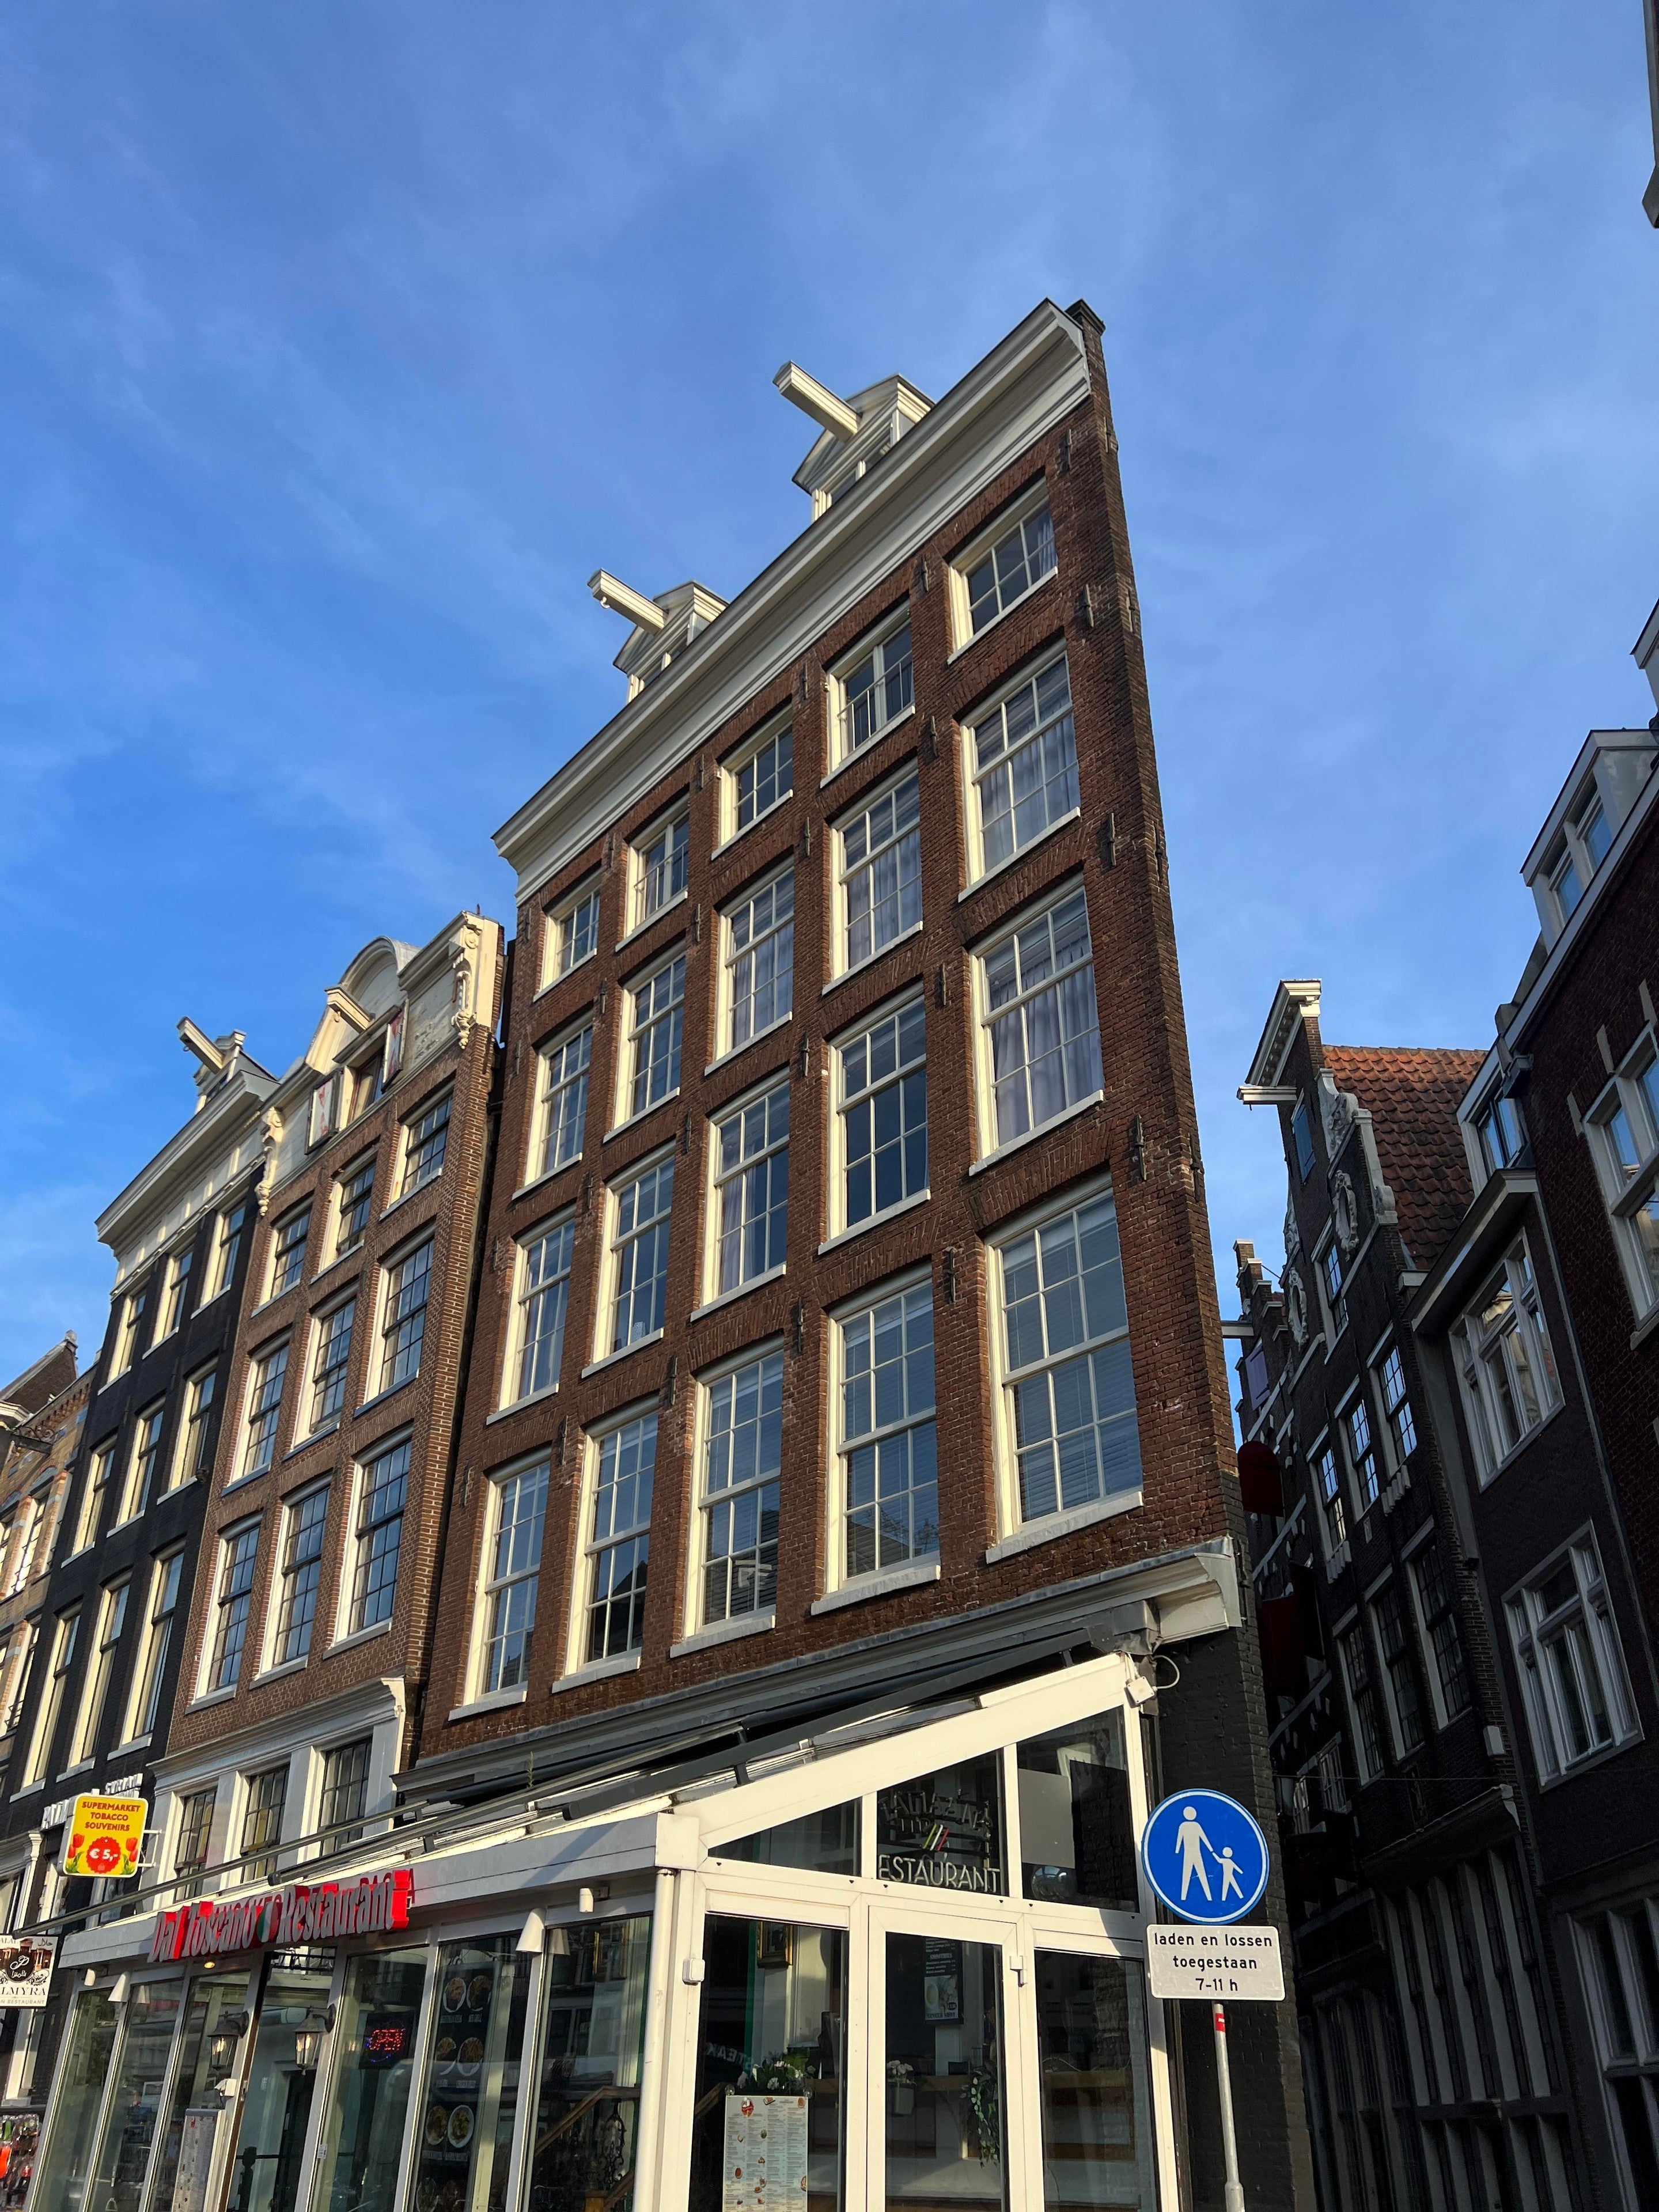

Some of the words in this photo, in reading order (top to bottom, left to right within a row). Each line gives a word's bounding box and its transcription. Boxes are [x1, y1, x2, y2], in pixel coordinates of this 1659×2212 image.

[82, 1801, 141, 1812] SUPERMARKET
[90, 1812, 128, 1821] TOBACCO
[85, 1822, 130, 1831] SOUVENIRS
[89, 1848, 100, 1859] €
[878, 1854, 1001, 1893] ESTAURANT
[147, 1906, 189, 1963] Dal
[181, 1900, 257, 1957] Toscano
[276, 1874, 400, 1944] Restaurant
[1154, 1933, 1194, 1945] laden
[1201, 1936, 1218, 1946] en
[1225, 1934, 1272, 1946] lossen
[1172, 1956, 1257, 1972] toegestaan
[1195, 1978, 1223, 1991] 7-11
[1229, 1979, 1238, 1991] h
